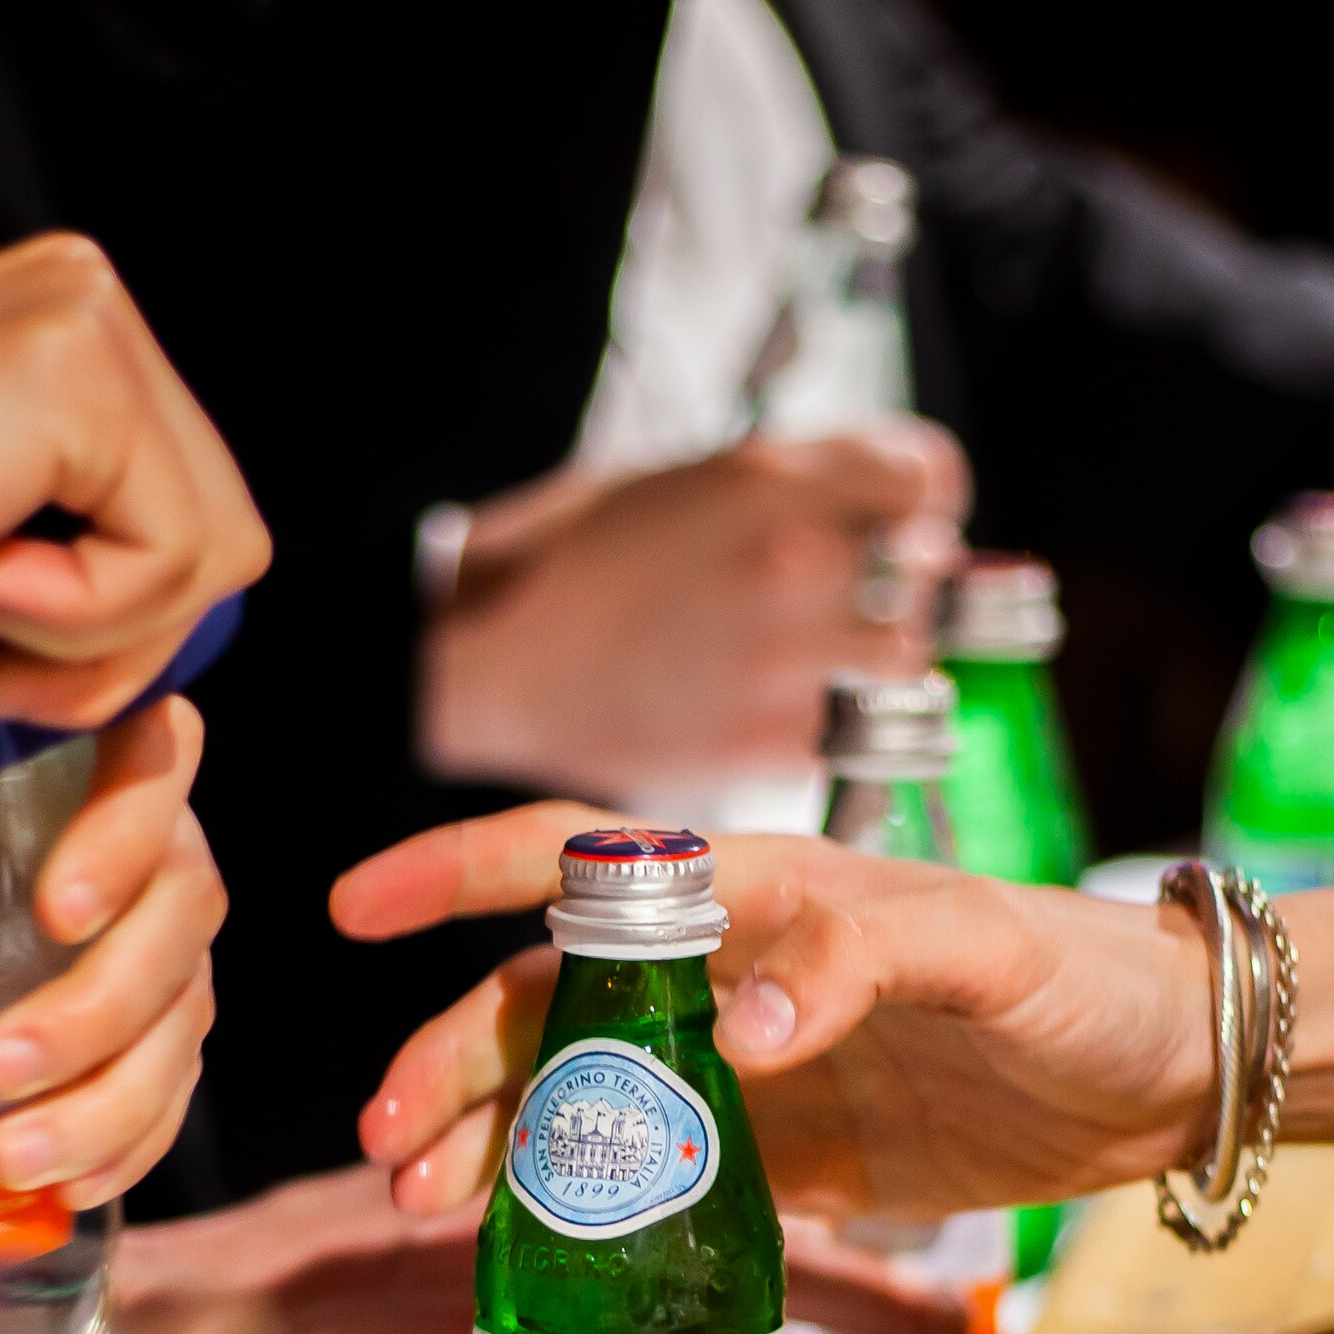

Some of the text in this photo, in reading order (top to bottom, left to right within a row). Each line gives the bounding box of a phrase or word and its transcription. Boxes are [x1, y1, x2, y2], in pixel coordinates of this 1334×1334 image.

[536, 1070, 664, 1190] SAN PELLEGRINO TERME ITALIA
[561, 1180, 621, 1202] 1899
